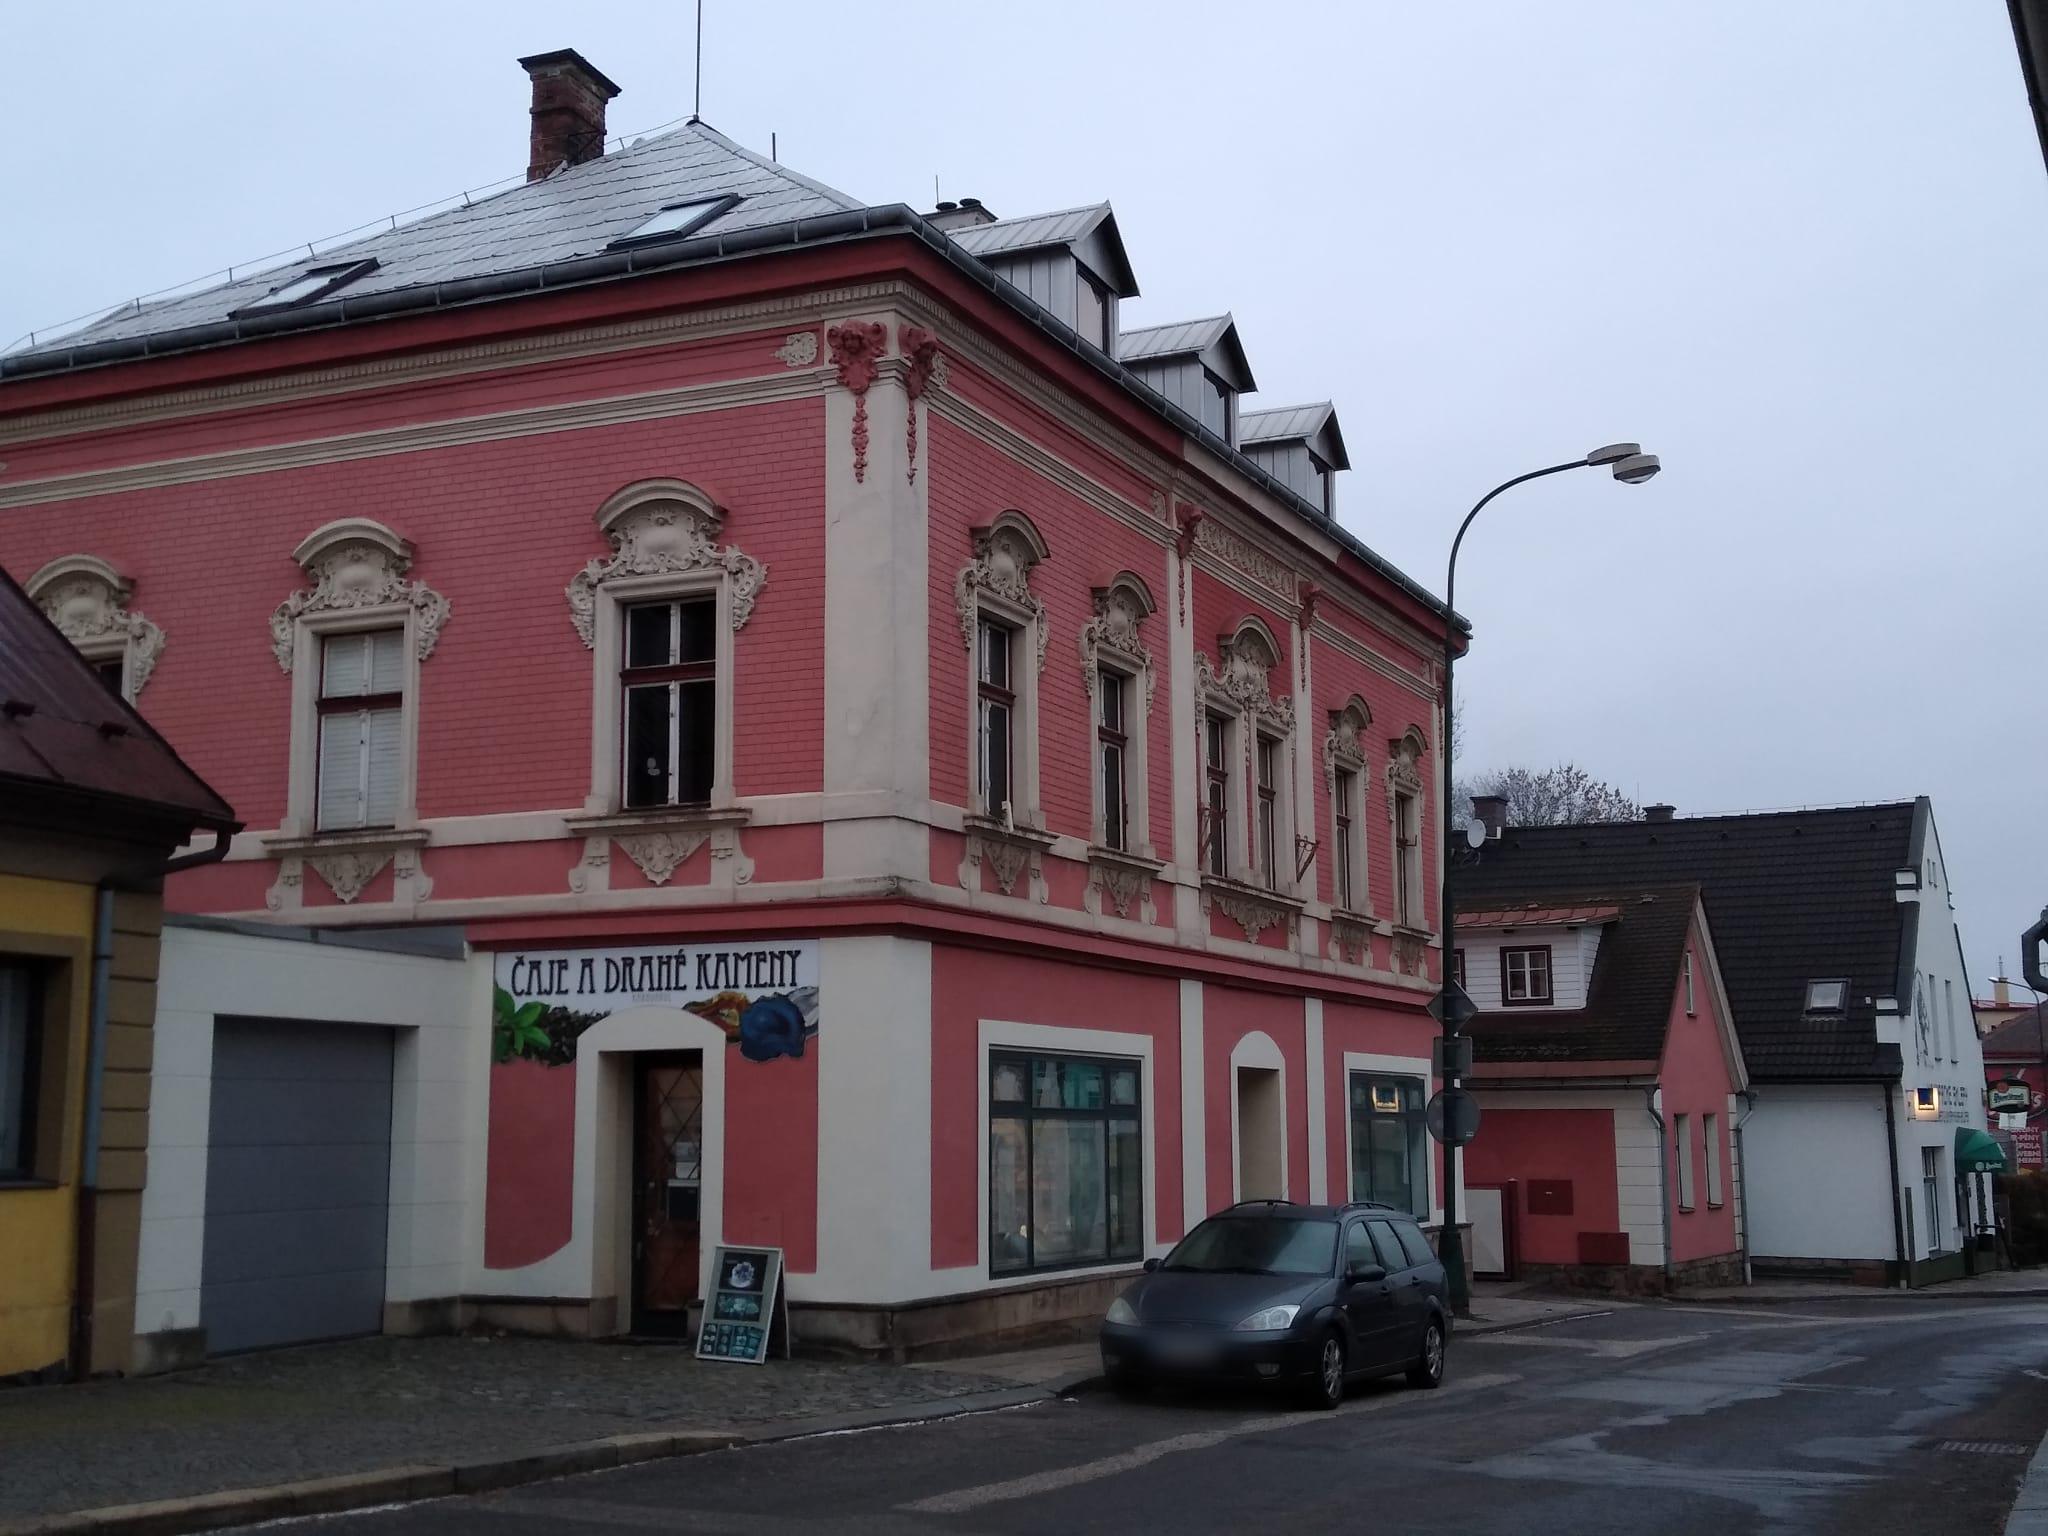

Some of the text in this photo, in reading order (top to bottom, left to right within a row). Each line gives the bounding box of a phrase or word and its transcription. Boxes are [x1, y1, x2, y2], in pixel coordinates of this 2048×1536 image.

[511, 949, 802, 996] ČAJE A DRAHÉ KAMENY
